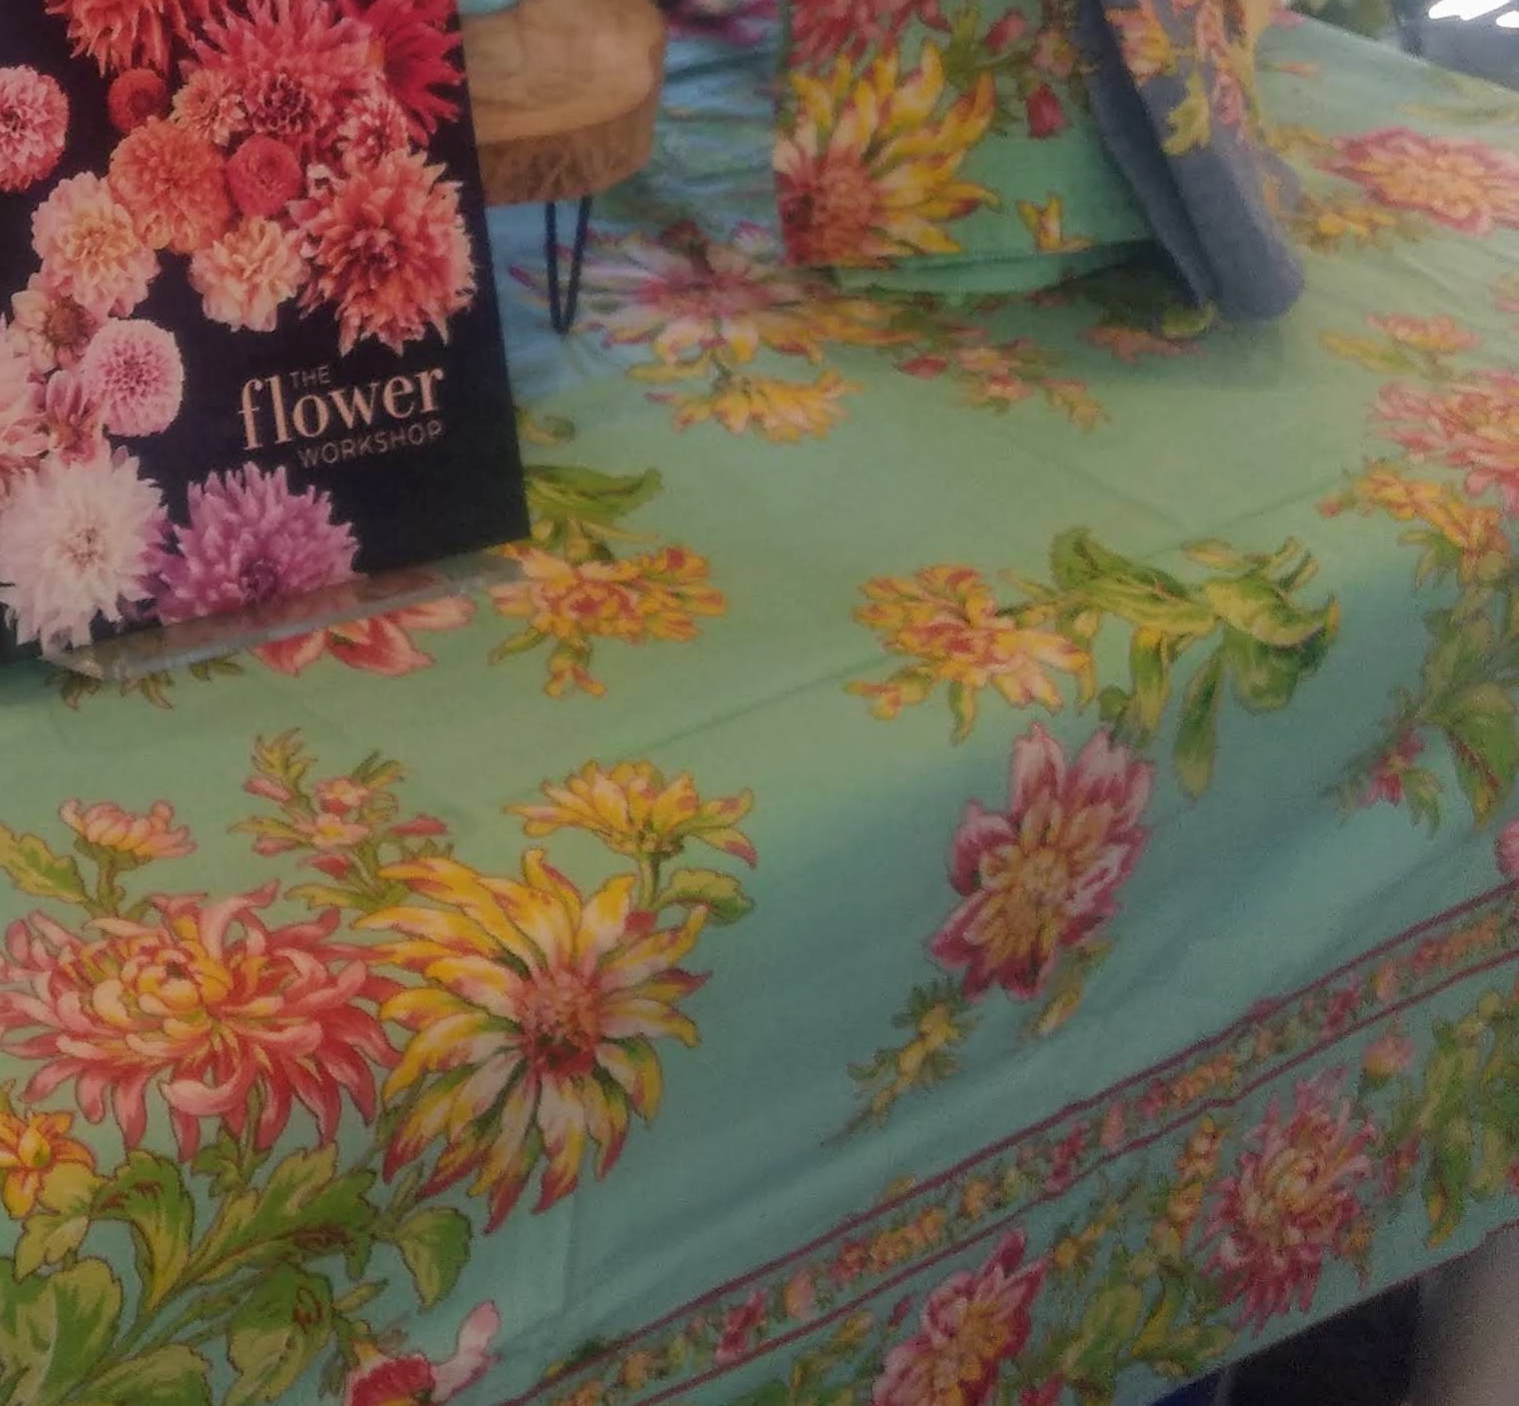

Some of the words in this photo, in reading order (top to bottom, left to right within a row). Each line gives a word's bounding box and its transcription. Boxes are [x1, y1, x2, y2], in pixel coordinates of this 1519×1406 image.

[289, 365, 331, 389] THE
[238, 367, 445, 451] flower
[298, 420, 443, 468] WORKSHOP
